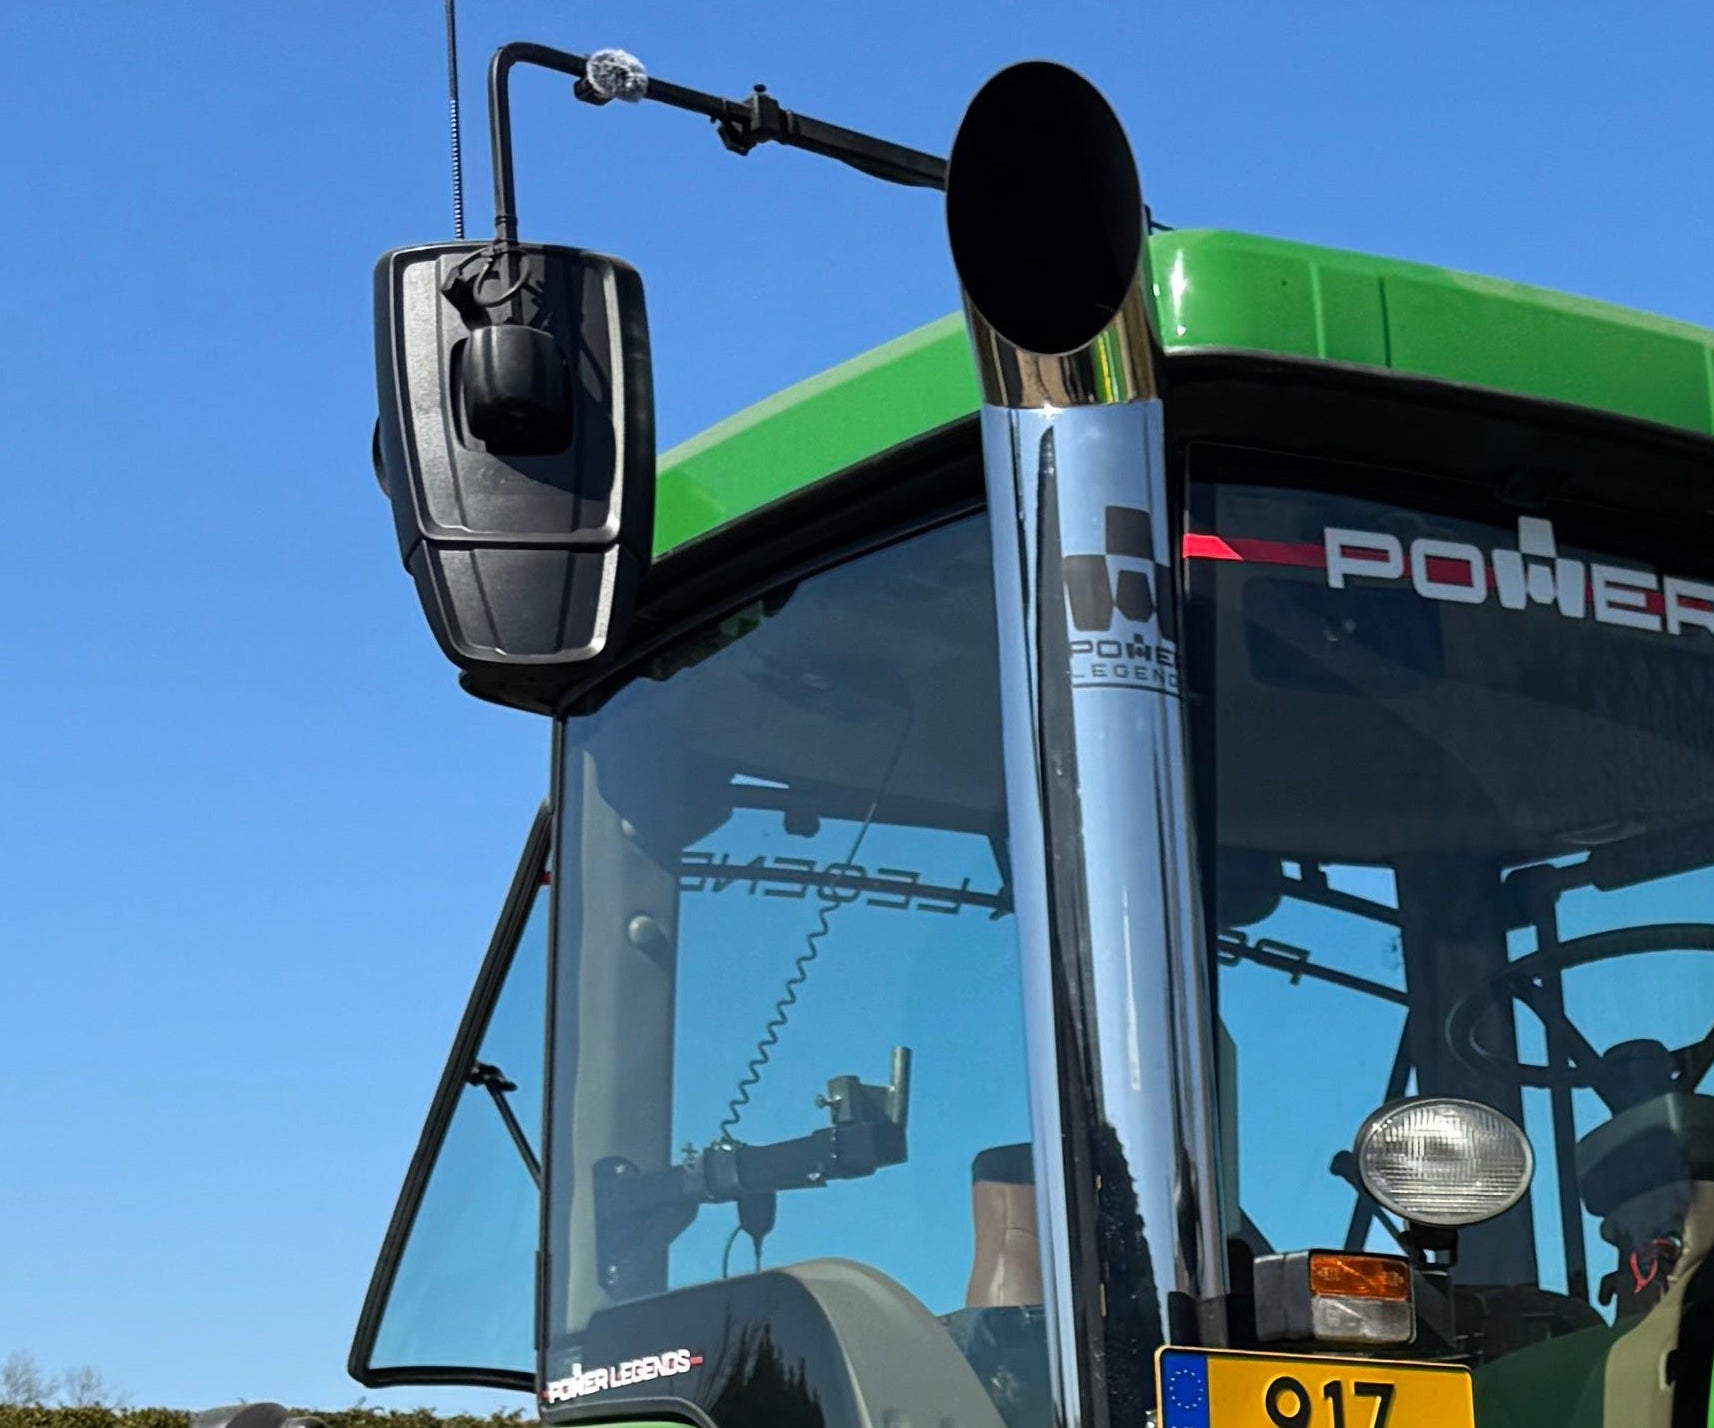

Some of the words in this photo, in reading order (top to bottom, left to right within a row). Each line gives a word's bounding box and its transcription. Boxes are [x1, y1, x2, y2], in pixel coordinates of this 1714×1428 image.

[1070, 633, 1177, 668] POWE
[547, 1362, 609, 1404] POWER
[609, 1348, 691, 1388] LEGENDS
